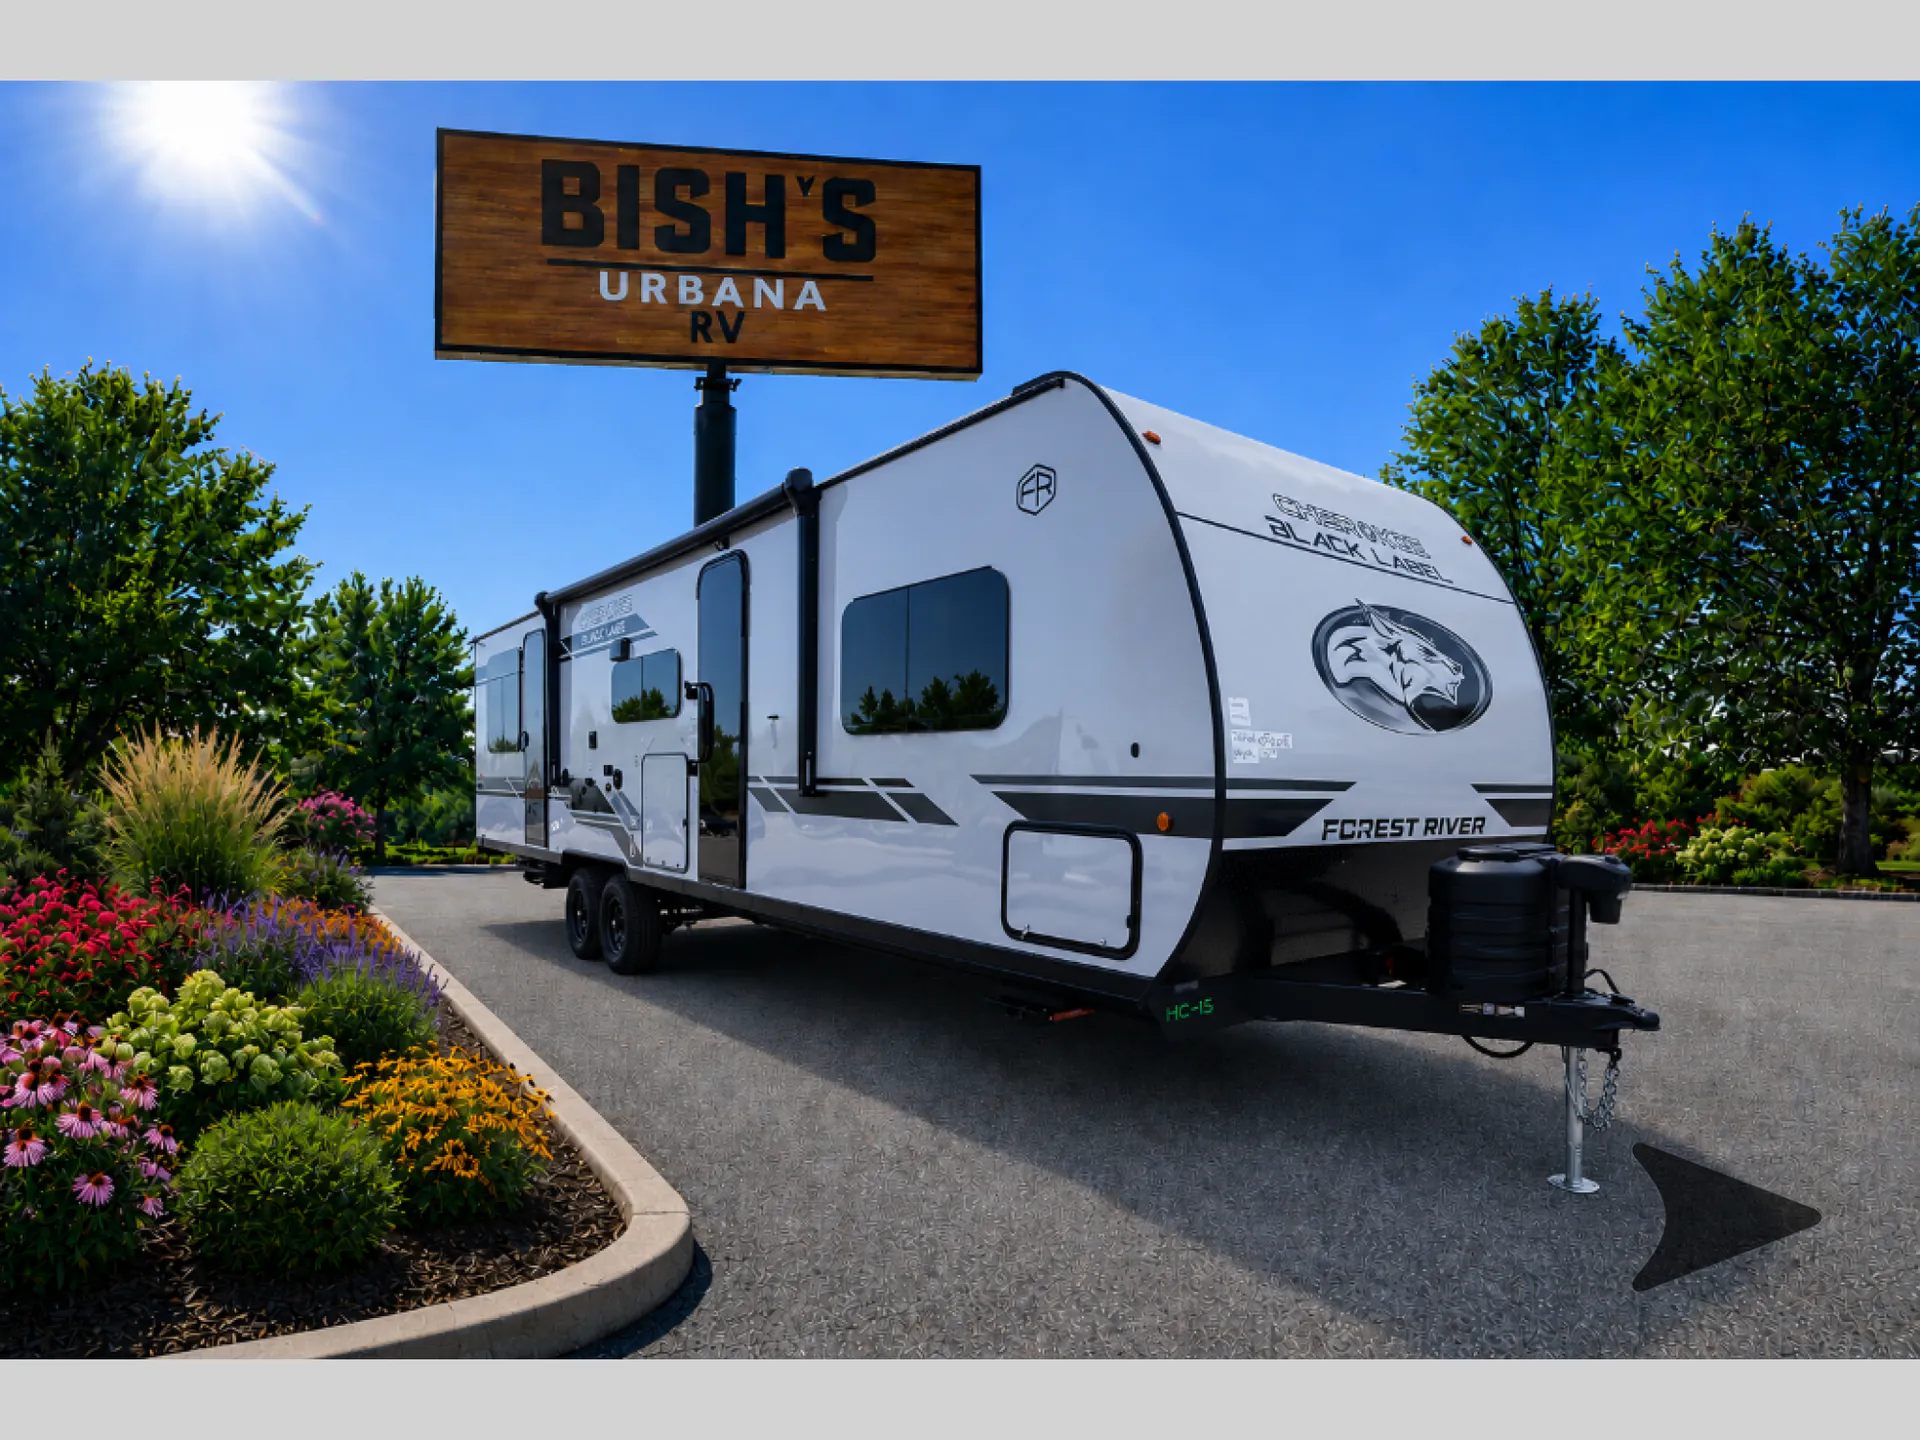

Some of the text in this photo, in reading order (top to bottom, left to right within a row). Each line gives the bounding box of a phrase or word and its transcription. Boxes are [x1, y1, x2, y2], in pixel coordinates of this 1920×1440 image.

[541, 159, 876, 263] BISH'S
[599, 270, 827, 312] URBANA
[690, 310, 745, 344] RV
[1264, 515, 1454, 584] BLACK LABEL
[1321, 816, 1486, 841] FOREST RIVER
[1165, 997, 1214, 1023] HC-15
